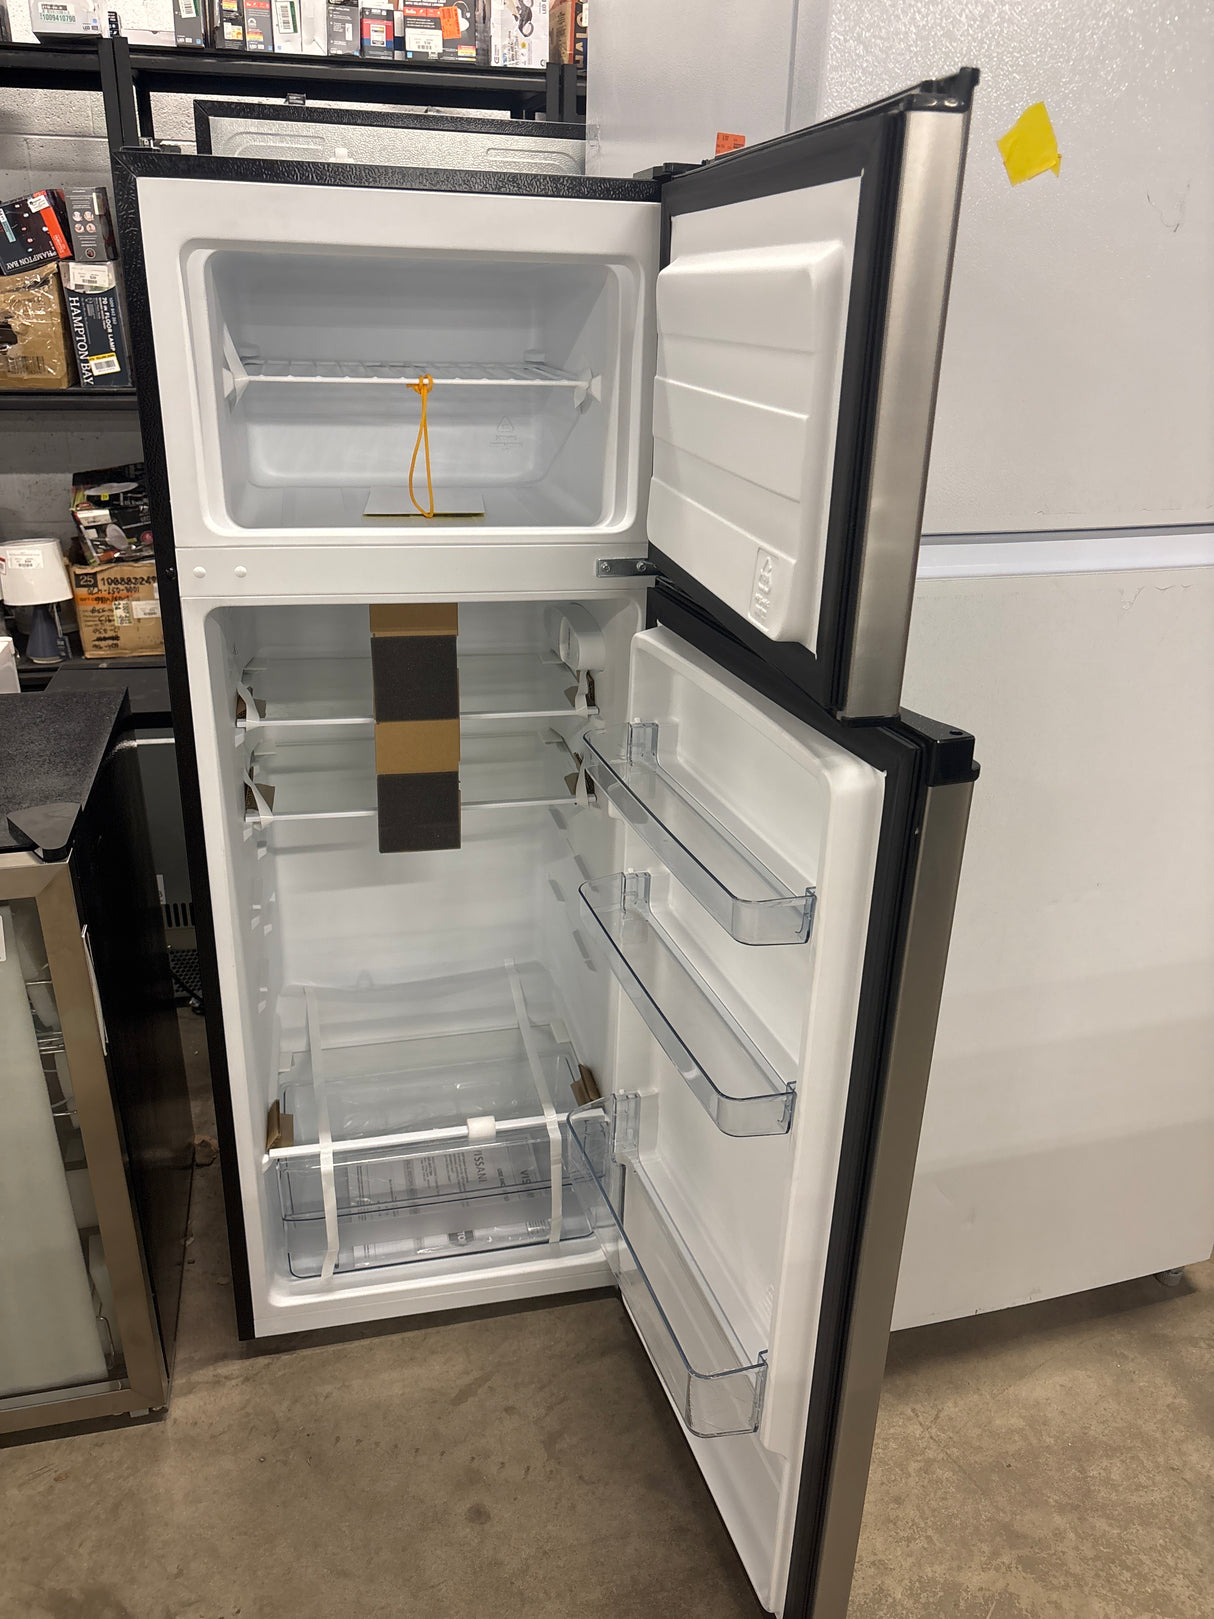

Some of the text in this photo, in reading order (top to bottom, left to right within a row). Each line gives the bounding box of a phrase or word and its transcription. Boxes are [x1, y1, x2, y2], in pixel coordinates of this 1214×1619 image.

[104, 312, 113, 333] FLOOR
[68, 296, 90, 360] HAMPTON
[80, 362, 94, 385] BAY
[108, 334, 116, 352] LAMP
[79, 574, 95, 586] 25
